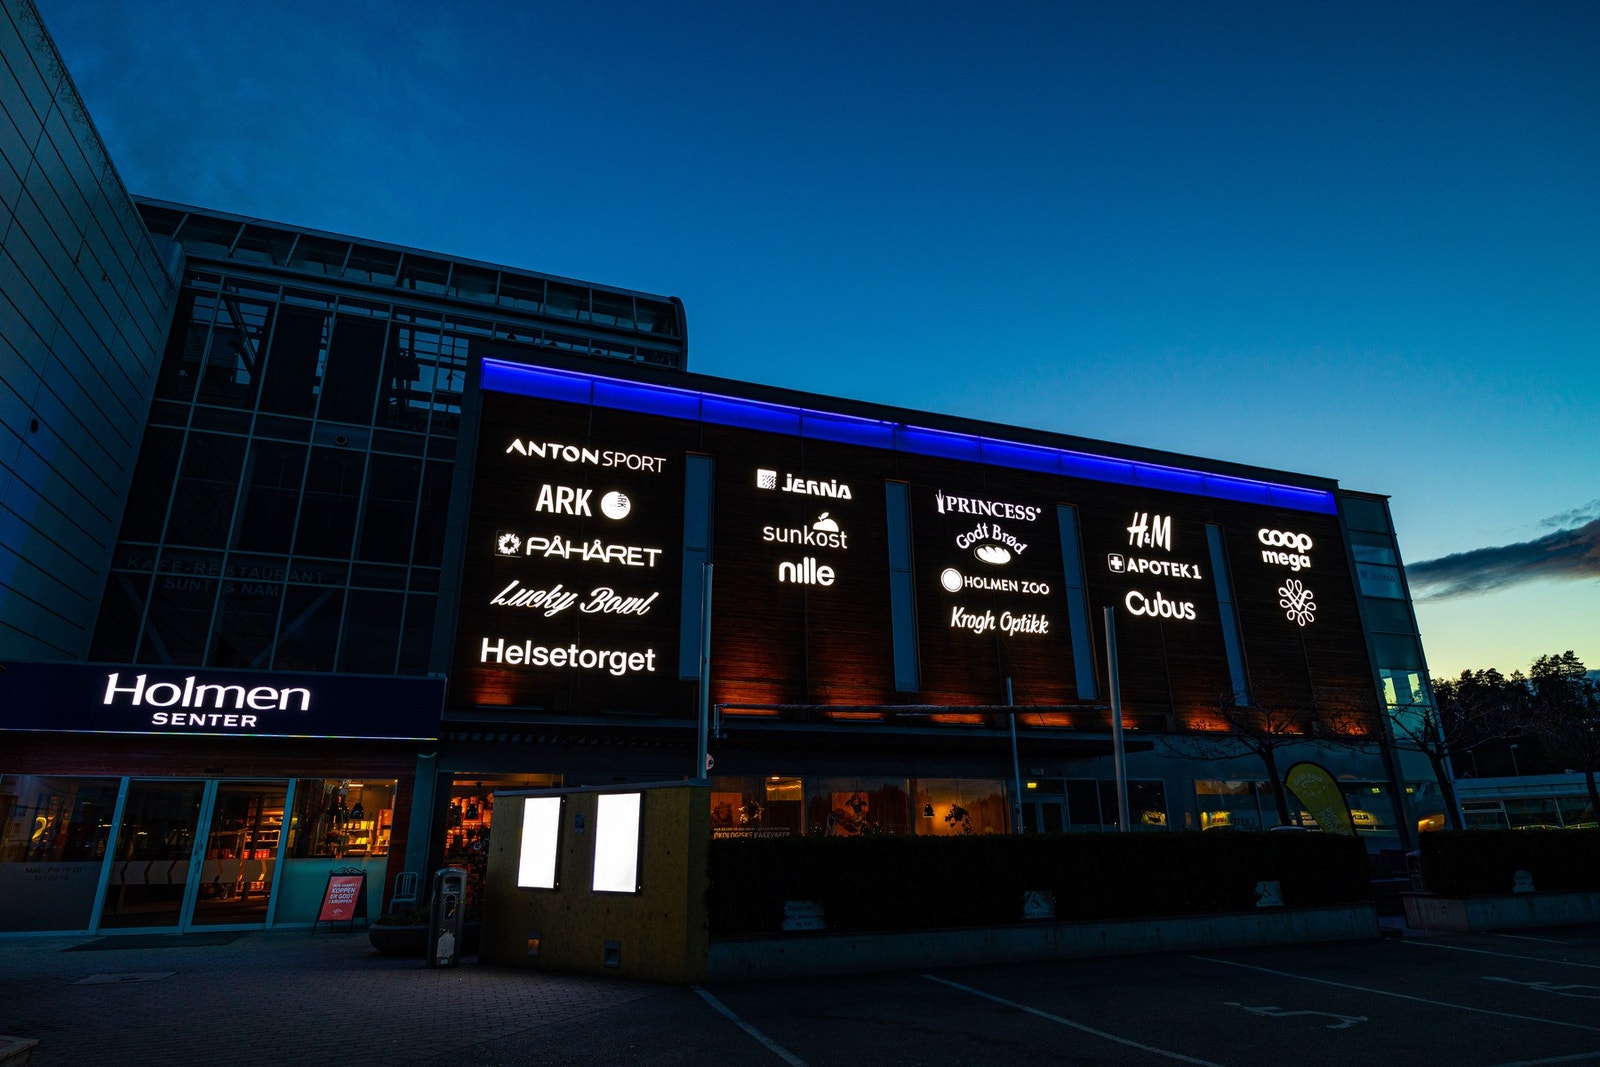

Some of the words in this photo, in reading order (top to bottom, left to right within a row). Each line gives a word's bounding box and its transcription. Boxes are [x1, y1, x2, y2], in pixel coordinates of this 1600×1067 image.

[535, 484, 593, 517] ARK
[945, 495, 1037, 522] PRINCESS
[763, 525, 848, 550] sunkost
[956, 522, 990, 550] Godt
[992, 523, 1028, 554] Brød
[1127, 511, 1171, 551] H&M
[1257, 528, 1313, 553] coop
[526, 535, 662, 568] PÅHÅRET
[1261, 550, 1311, 572] mega
[778, 556, 836, 586] nille
[964, 575, 1019, 592] HOLMEN
[1021, 581, 1050, 595] ZOO
[489, 579, 579, 618] Lucky
[579, 587, 660, 616] Bowl
[1125, 590, 1197, 621] Cubus
[950, 605, 997, 635] Krogh
[1000, 611, 1049, 637] Optikk
[480, 637, 656, 676] Helsetorget
[103, 673, 311, 711] Holmen
[151, 711, 258, 728] SENTER
